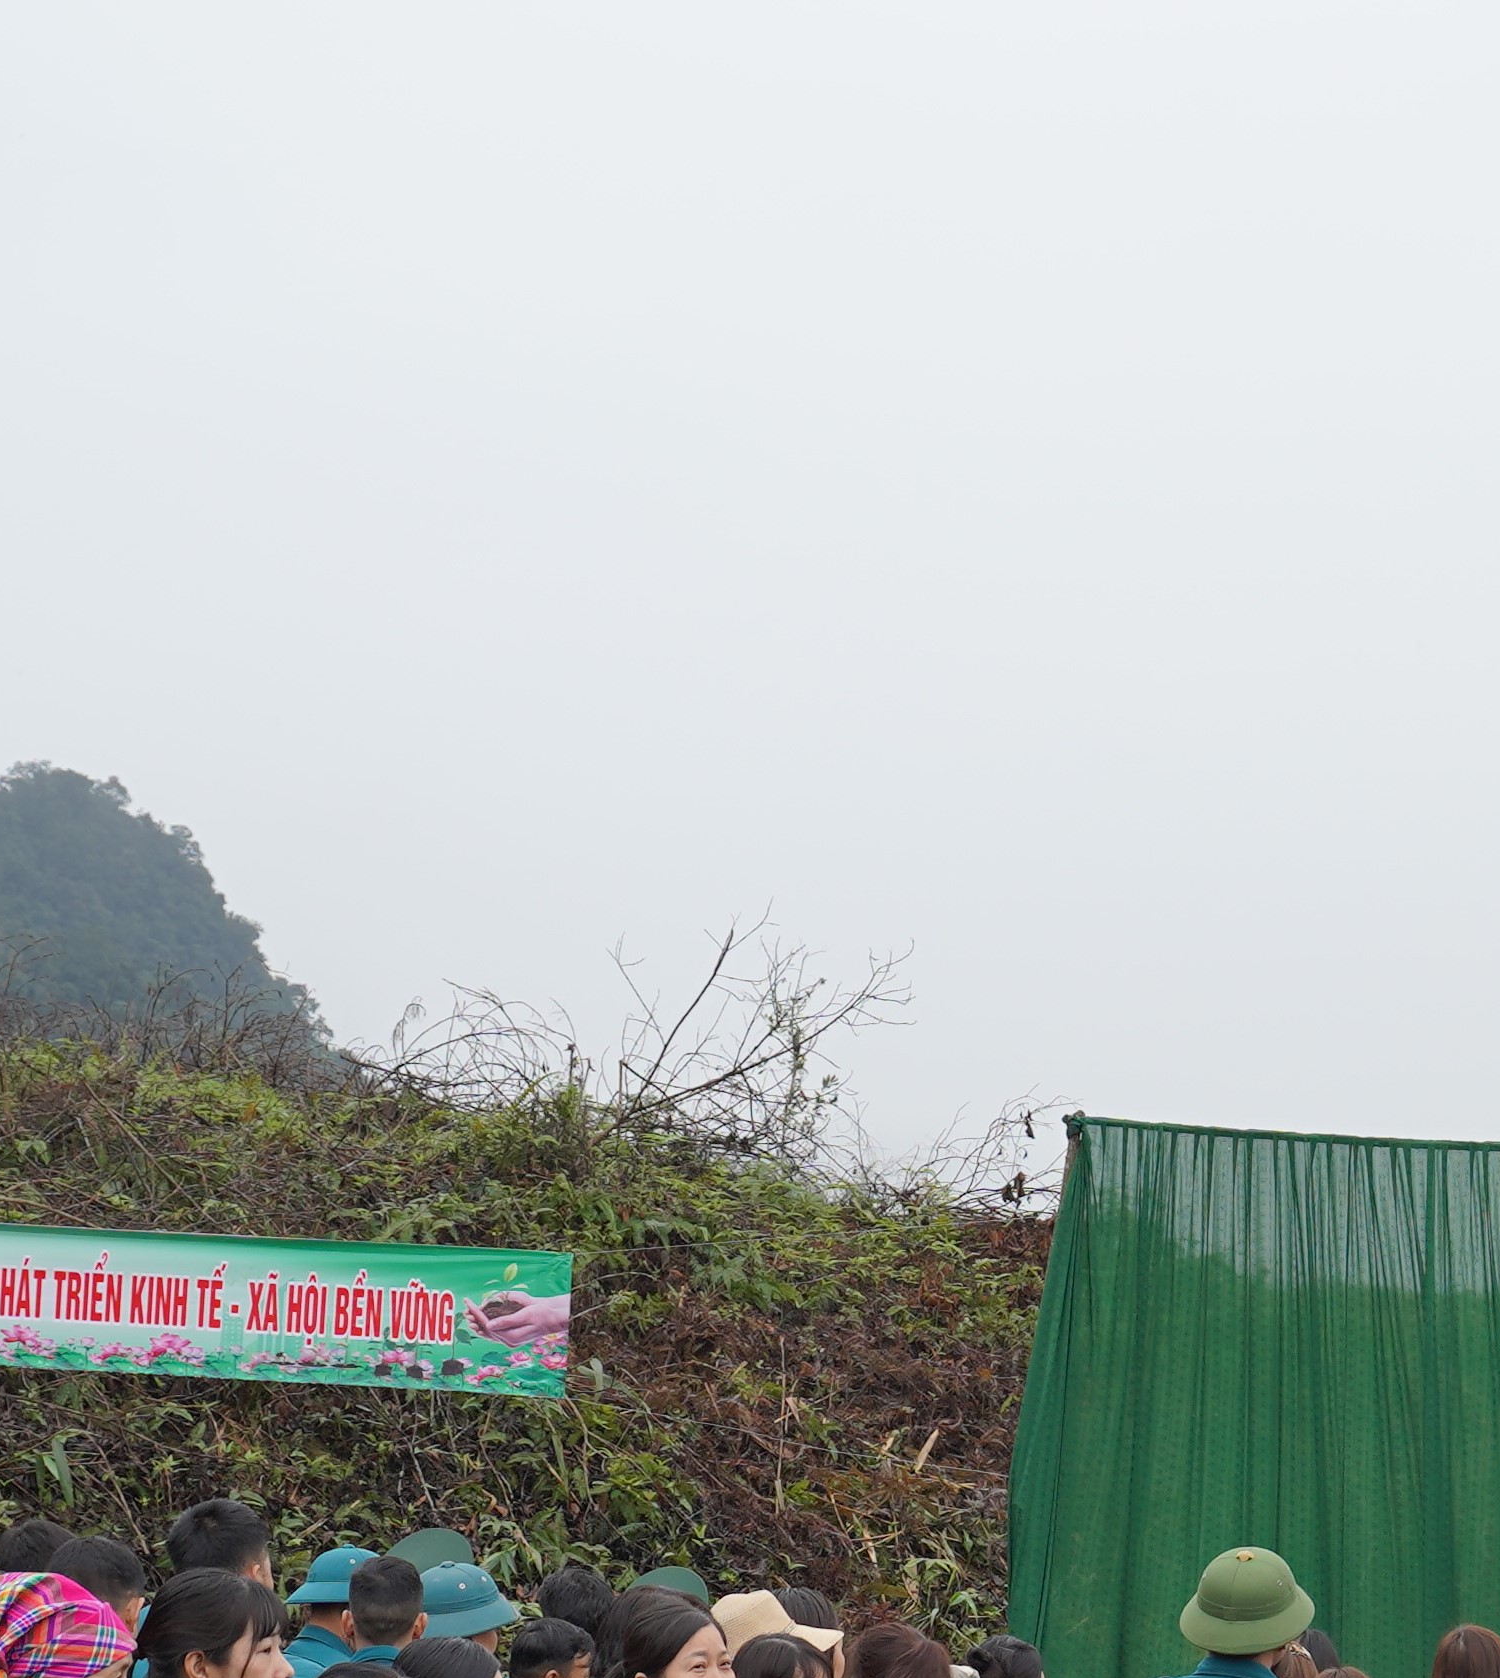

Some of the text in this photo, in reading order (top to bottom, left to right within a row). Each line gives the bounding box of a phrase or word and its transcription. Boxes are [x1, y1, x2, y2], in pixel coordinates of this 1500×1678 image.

[54, 1253, 123, 1323] TRIỂN
[130, 1275, 188, 1327] KINH
[197, 1264, 227, 1329] TẾ
[247, 1273, 278, 1332] XÃ
[287, 1274, 327, 1345] HỘI
[334, 1272, 382, 1337] BỀN
[390, 1280, 453, 1344] VỮNG
